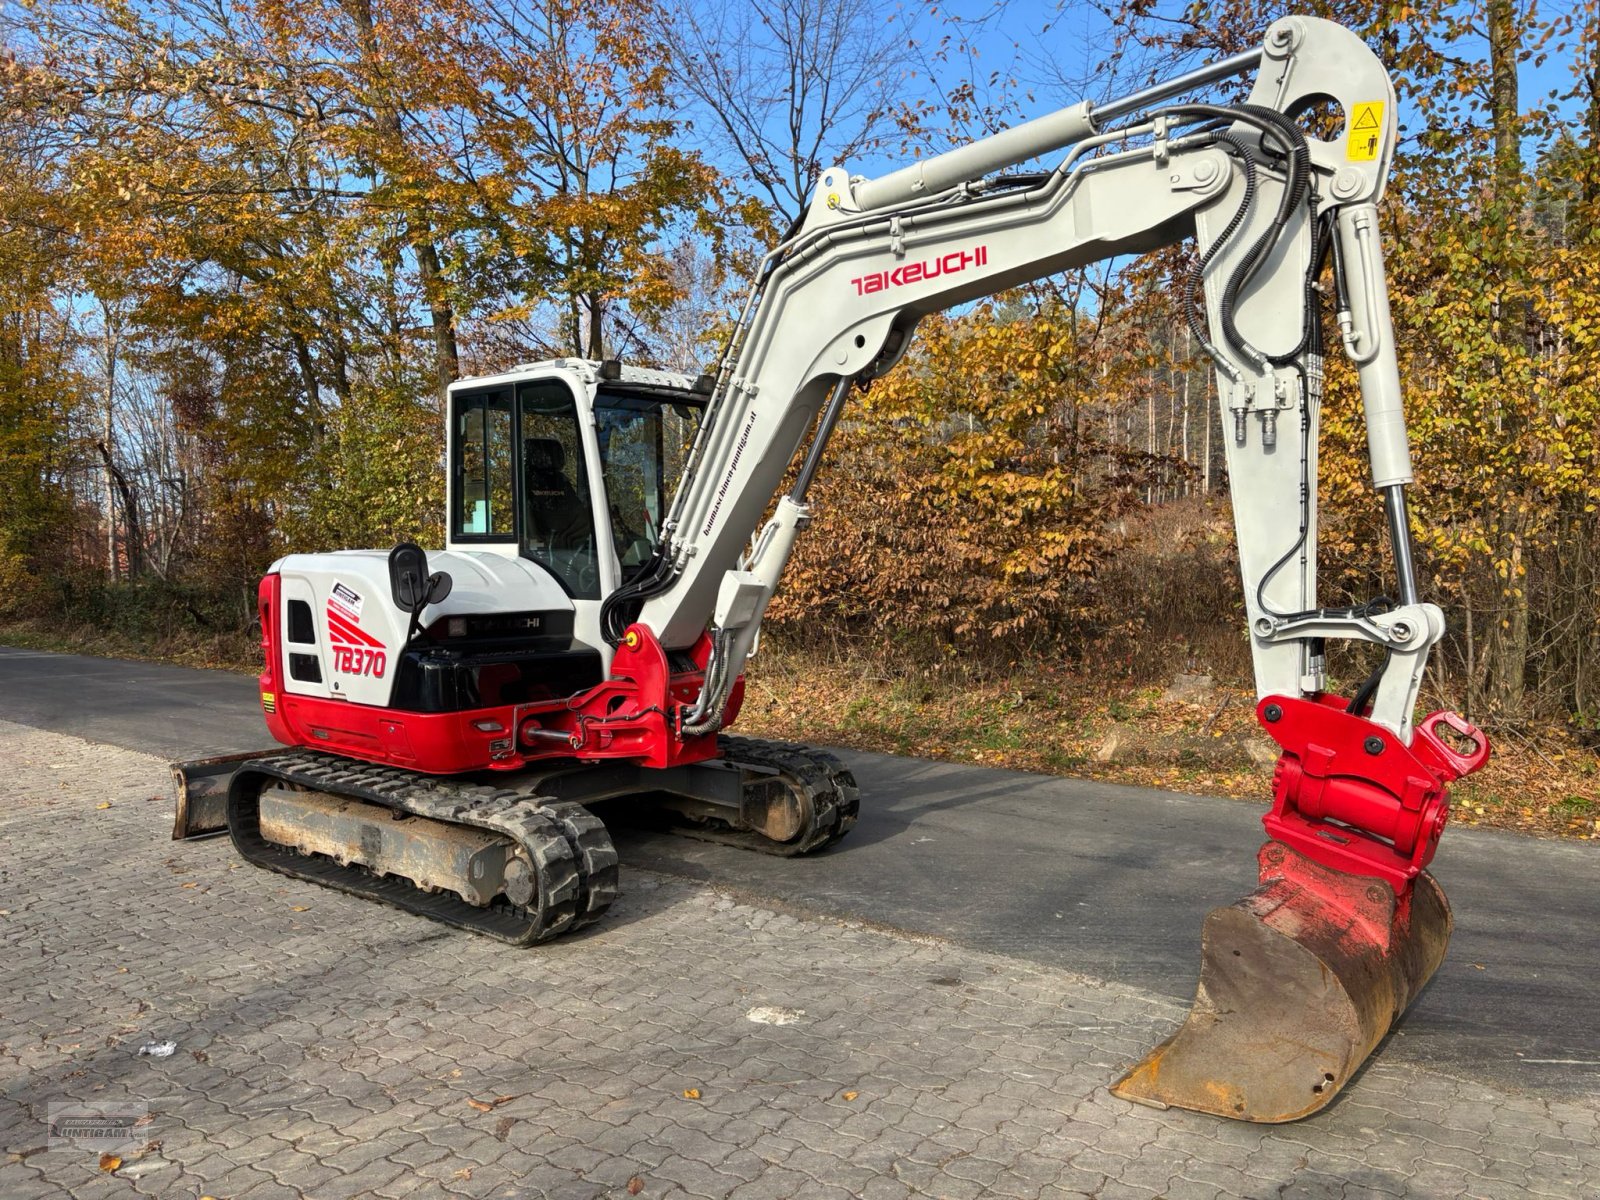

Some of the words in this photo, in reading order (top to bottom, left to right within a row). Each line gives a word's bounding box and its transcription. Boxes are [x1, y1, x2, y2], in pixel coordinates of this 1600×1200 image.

[851, 246, 987, 296] TAKEUCHI
[703, 411, 757, 537] baumaschinen-puntigam.at
[332, 645, 387, 679] TB370
